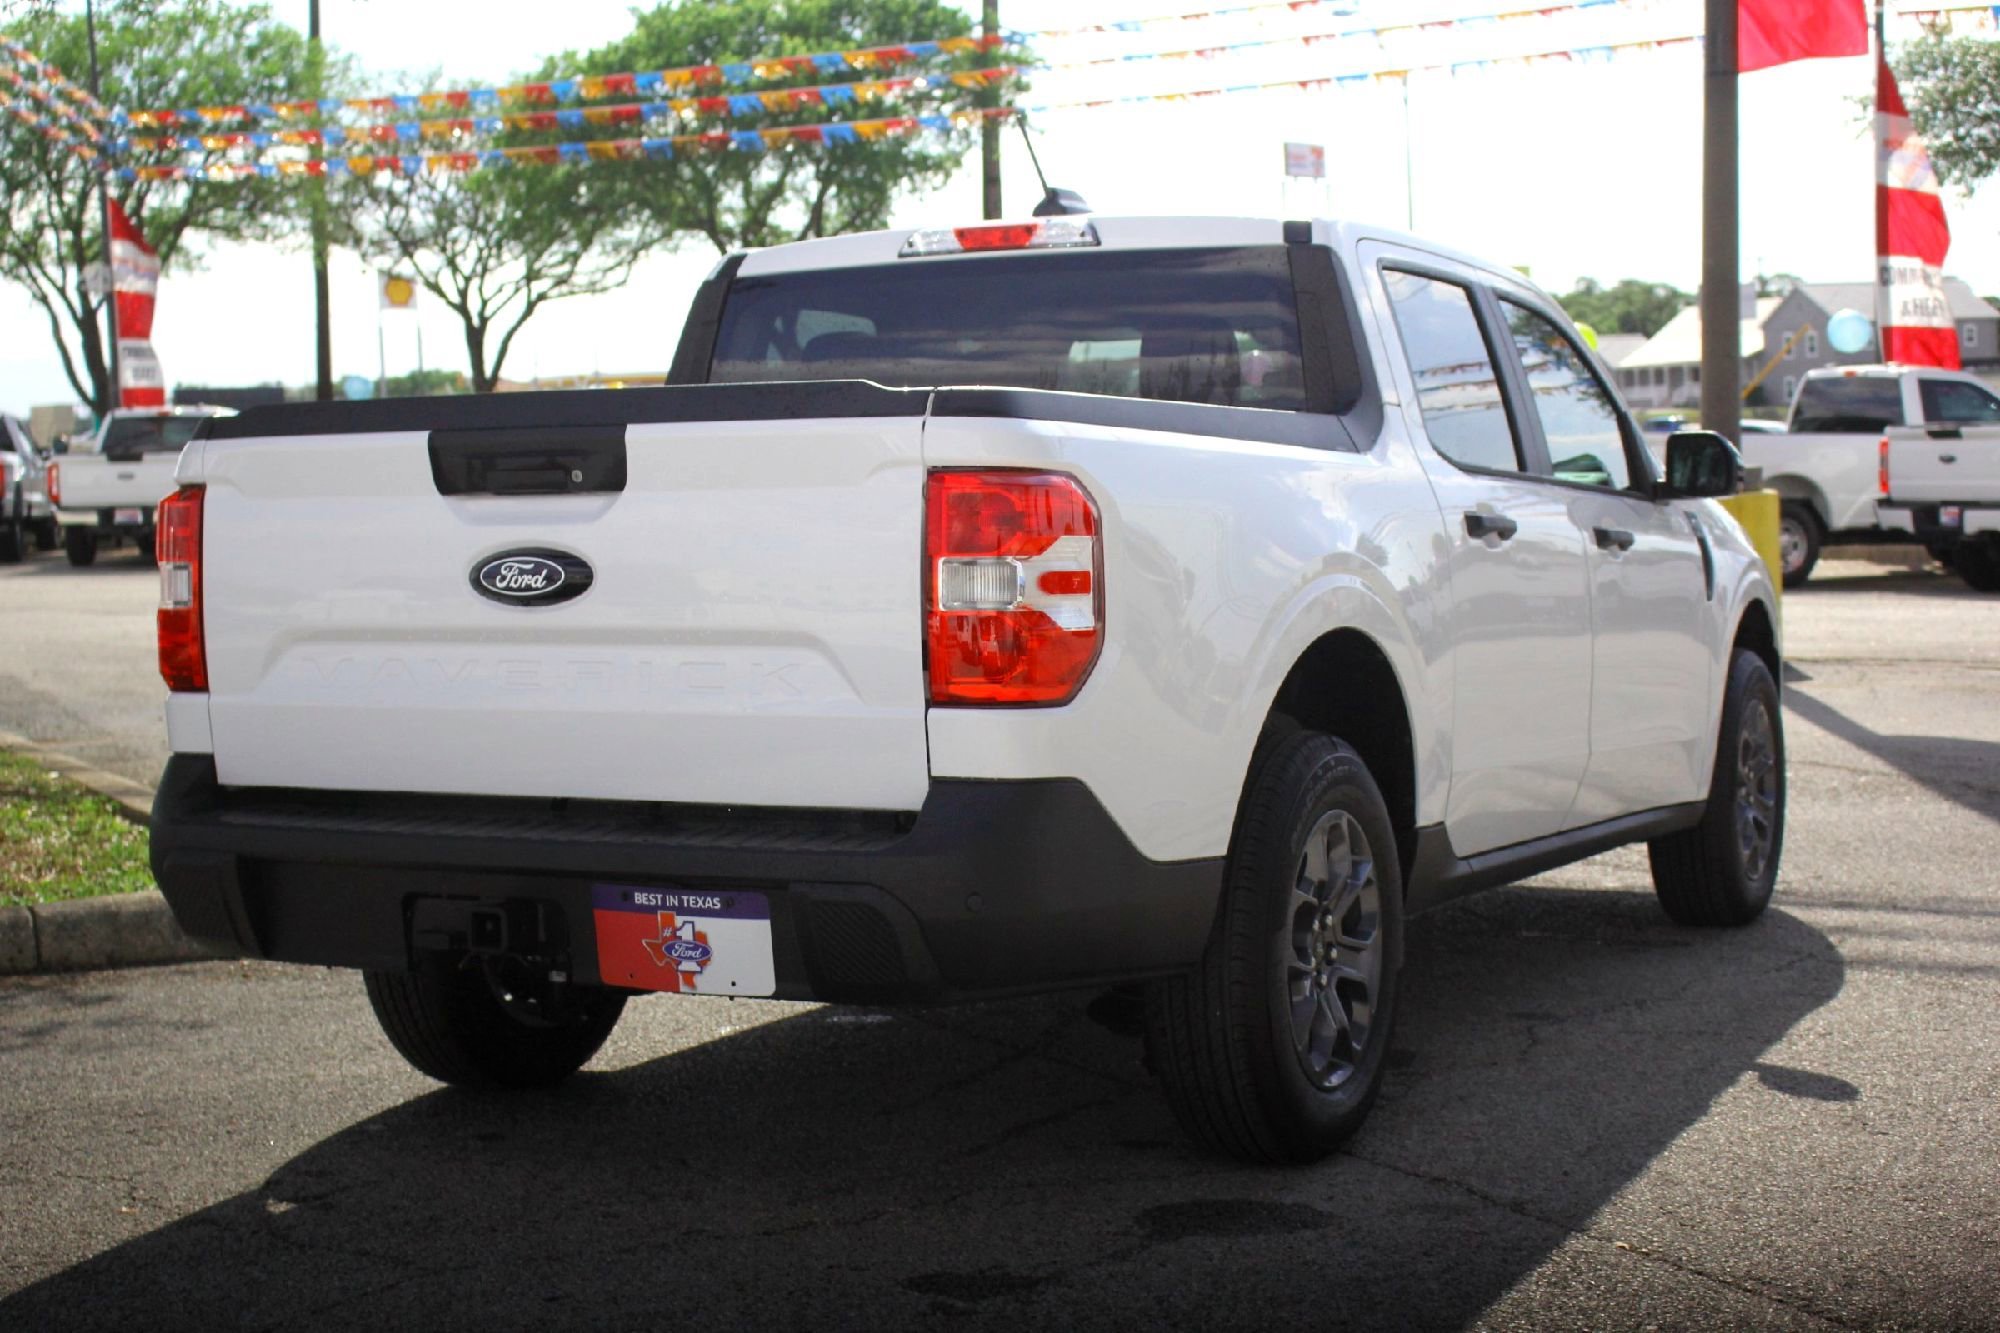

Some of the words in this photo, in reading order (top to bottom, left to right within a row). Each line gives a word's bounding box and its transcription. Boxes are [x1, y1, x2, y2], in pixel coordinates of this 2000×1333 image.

[496, 562, 548, 589] Ford
[301, 657, 803, 696] MAVERICK
[634, 892, 663, 906] BEST
[666, 895, 679, 907] IN
[681, 895, 721, 909] TEXAS
[671, 942, 702, 958] Ford
